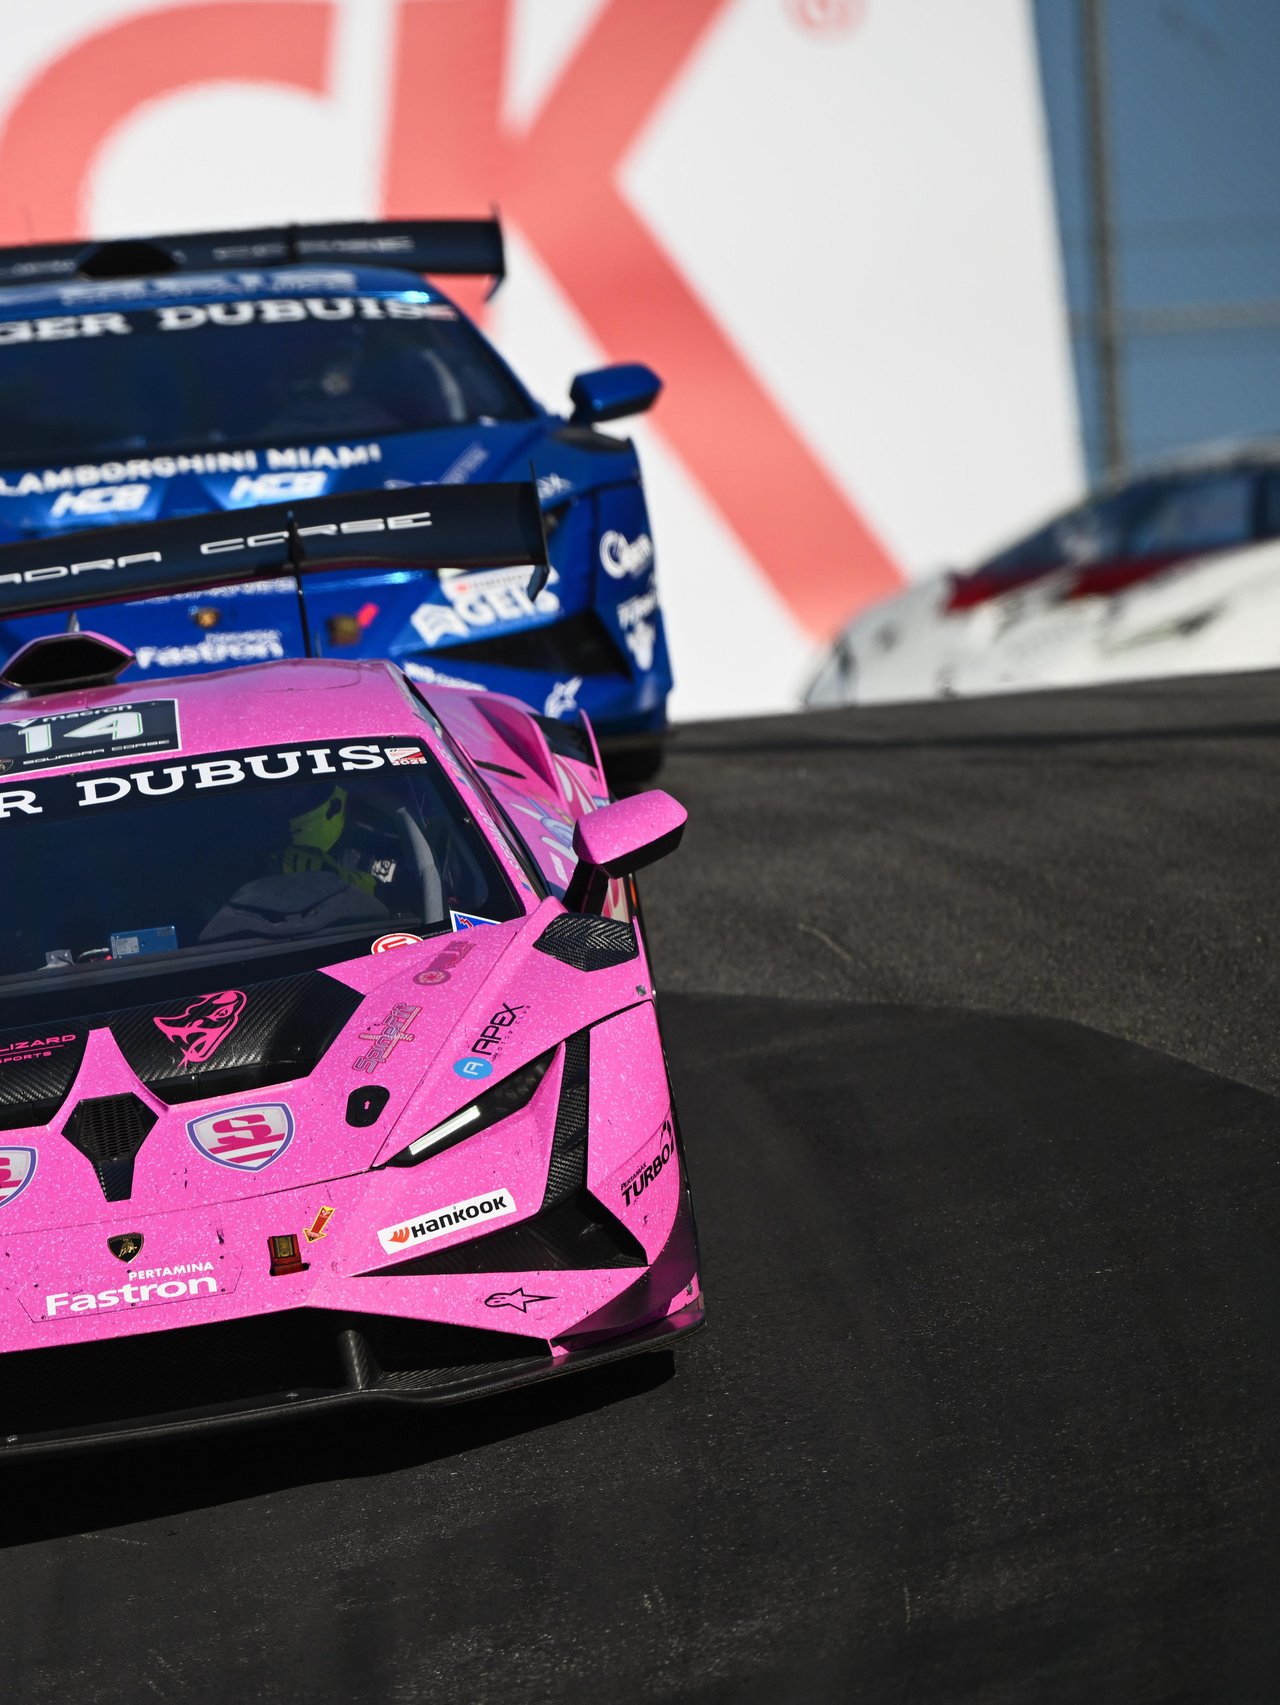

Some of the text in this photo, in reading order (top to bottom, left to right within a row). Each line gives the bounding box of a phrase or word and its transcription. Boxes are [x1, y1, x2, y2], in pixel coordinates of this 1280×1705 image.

[158, 297, 424, 332] DUBUIS
[265, 443, 382, 470] MIAMI
[200, 511, 432, 555] CORSE
[17, 711, 144, 754] 14
[42, 703, 133, 723] macron
[22, 748, 105, 766] SQUADRA
[111, 739, 170, 751] CORSE
[75, 744, 386, 806] DUBUIS
[471, 1002, 525, 1056] APEX
[621, 1143, 671, 1208] TURBO
[128, 1261, 215, 1282] PERTAMINA
[45, 1276, 218, 1317] Fastron
